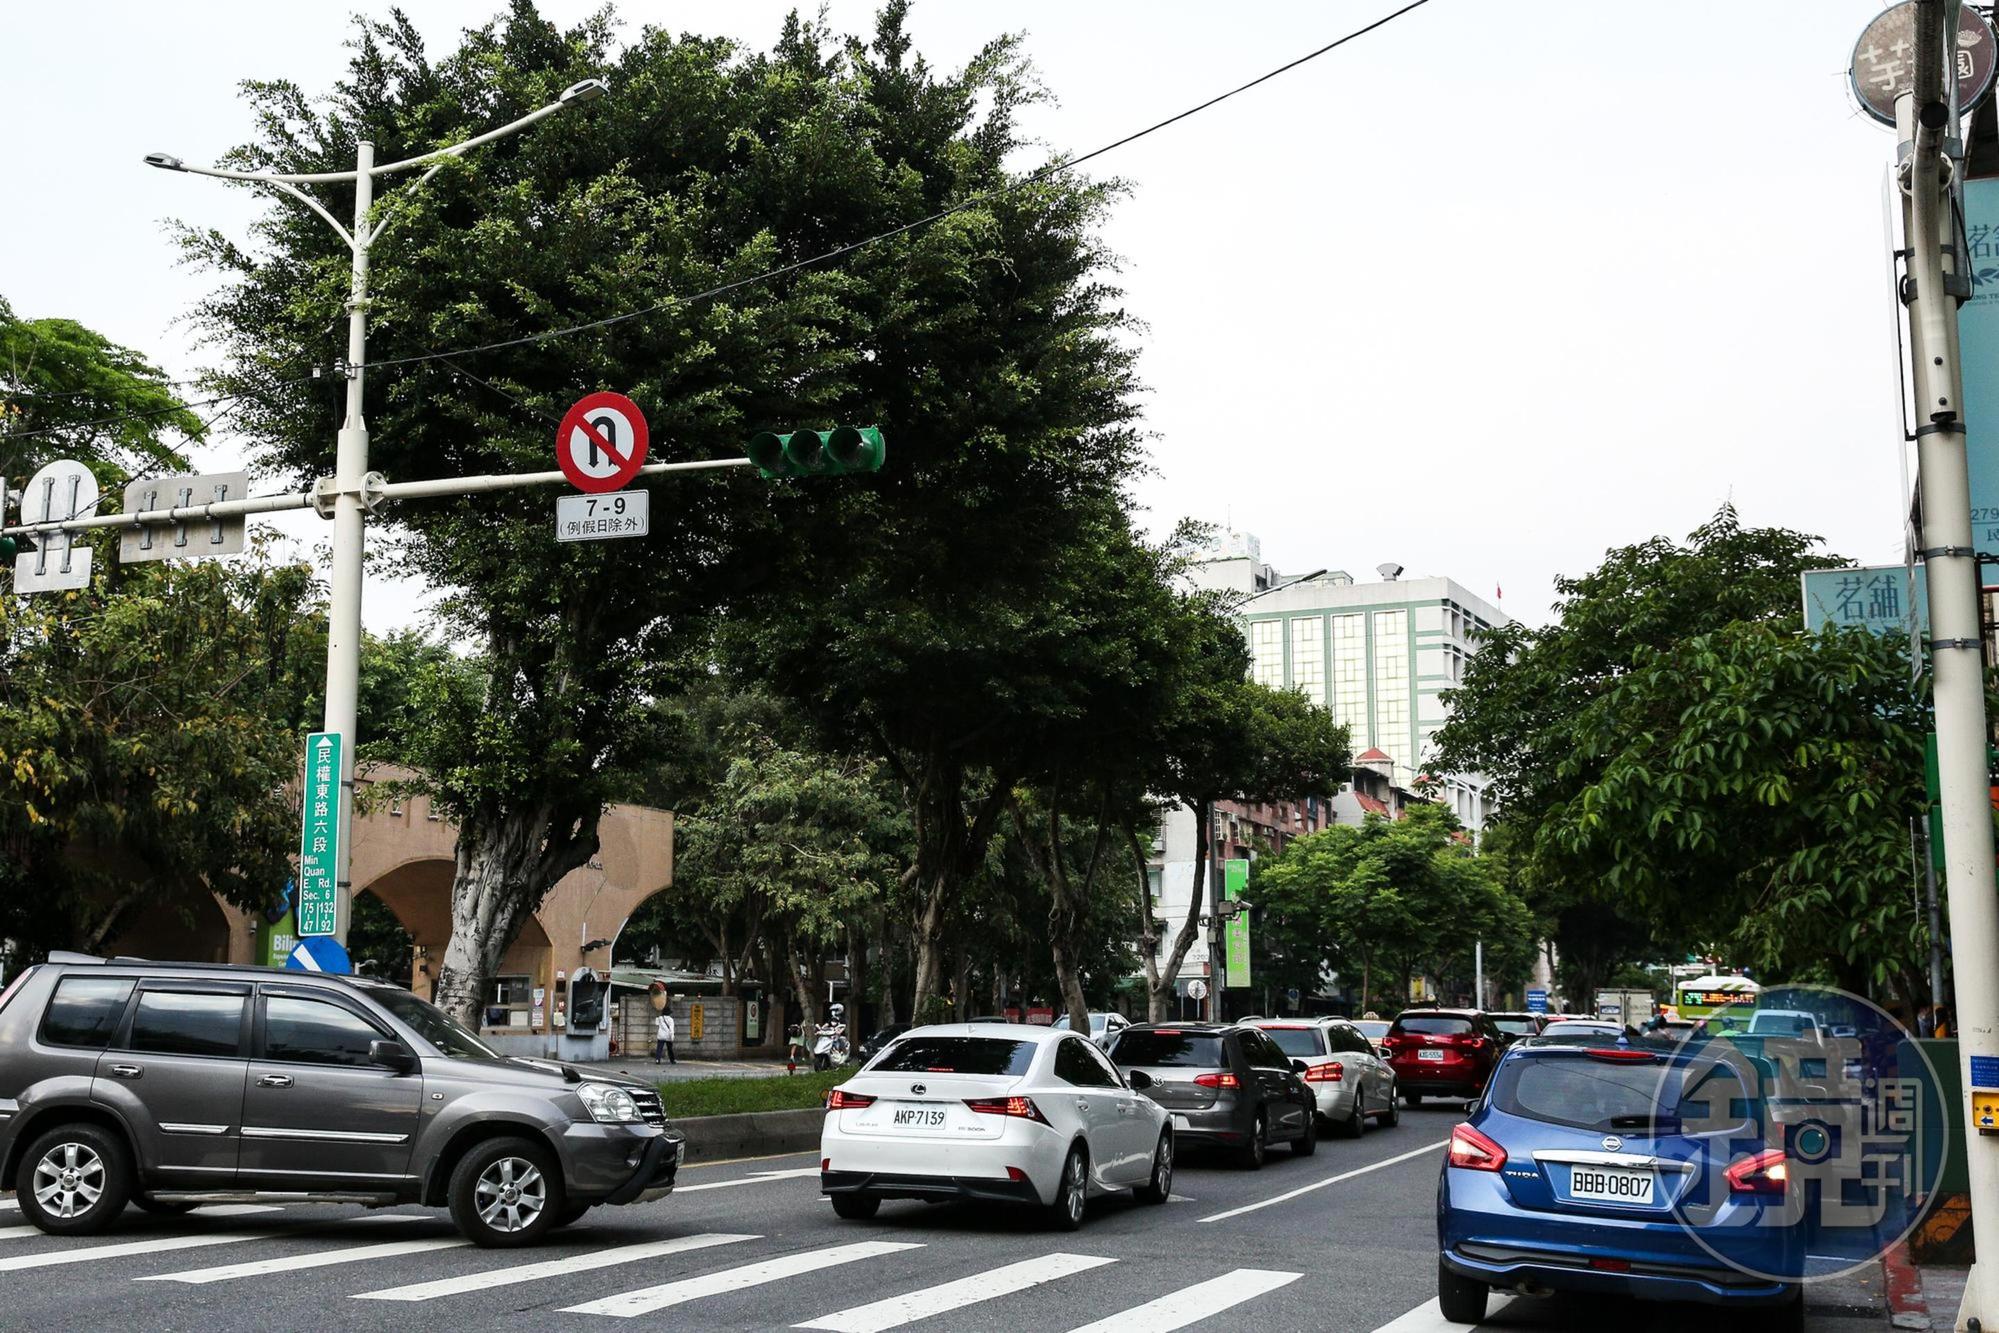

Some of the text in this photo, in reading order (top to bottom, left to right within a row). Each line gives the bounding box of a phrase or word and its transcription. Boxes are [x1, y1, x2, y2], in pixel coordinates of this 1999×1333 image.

[312, 747, 332, 853] 民權東路六段
[304, 855, 319, 865] Min
[303, 867, 325, 877] Quan
[303, 877, 332, 889] E. Rd.
[303, 889, 331, 901] Sec. 6
[304, 901, 334, 914] 75 132
[303, 919, 331, 932] 47 92
